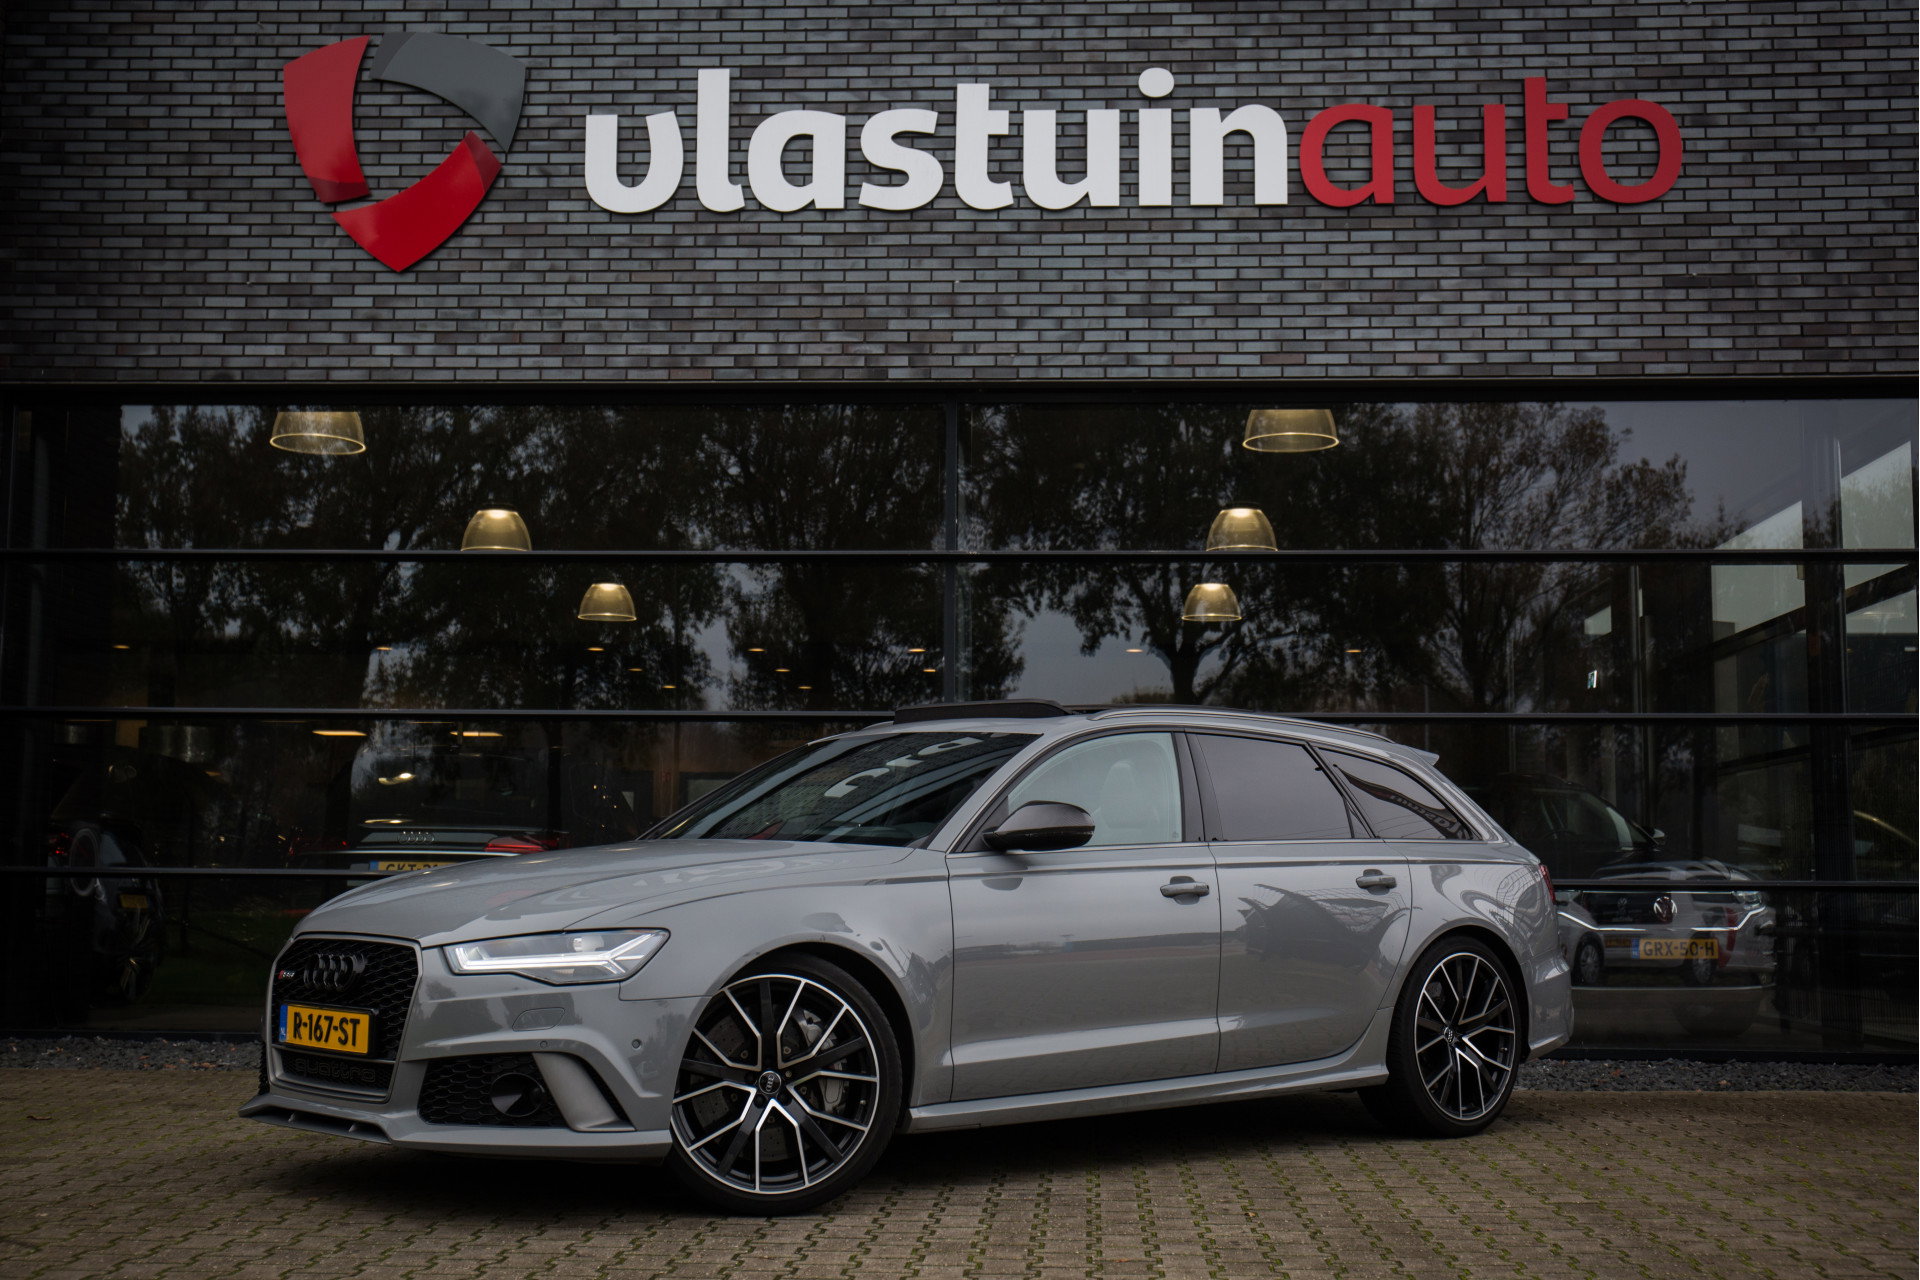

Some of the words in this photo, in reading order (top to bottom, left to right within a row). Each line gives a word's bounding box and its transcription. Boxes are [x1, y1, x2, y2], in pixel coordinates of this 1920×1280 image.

[584, 66, 1685, 213] vlastuinauto
[1643, 940, 1715, 957] GRX-50-H
[293, 1011, 361, 1047] R-167-ST
